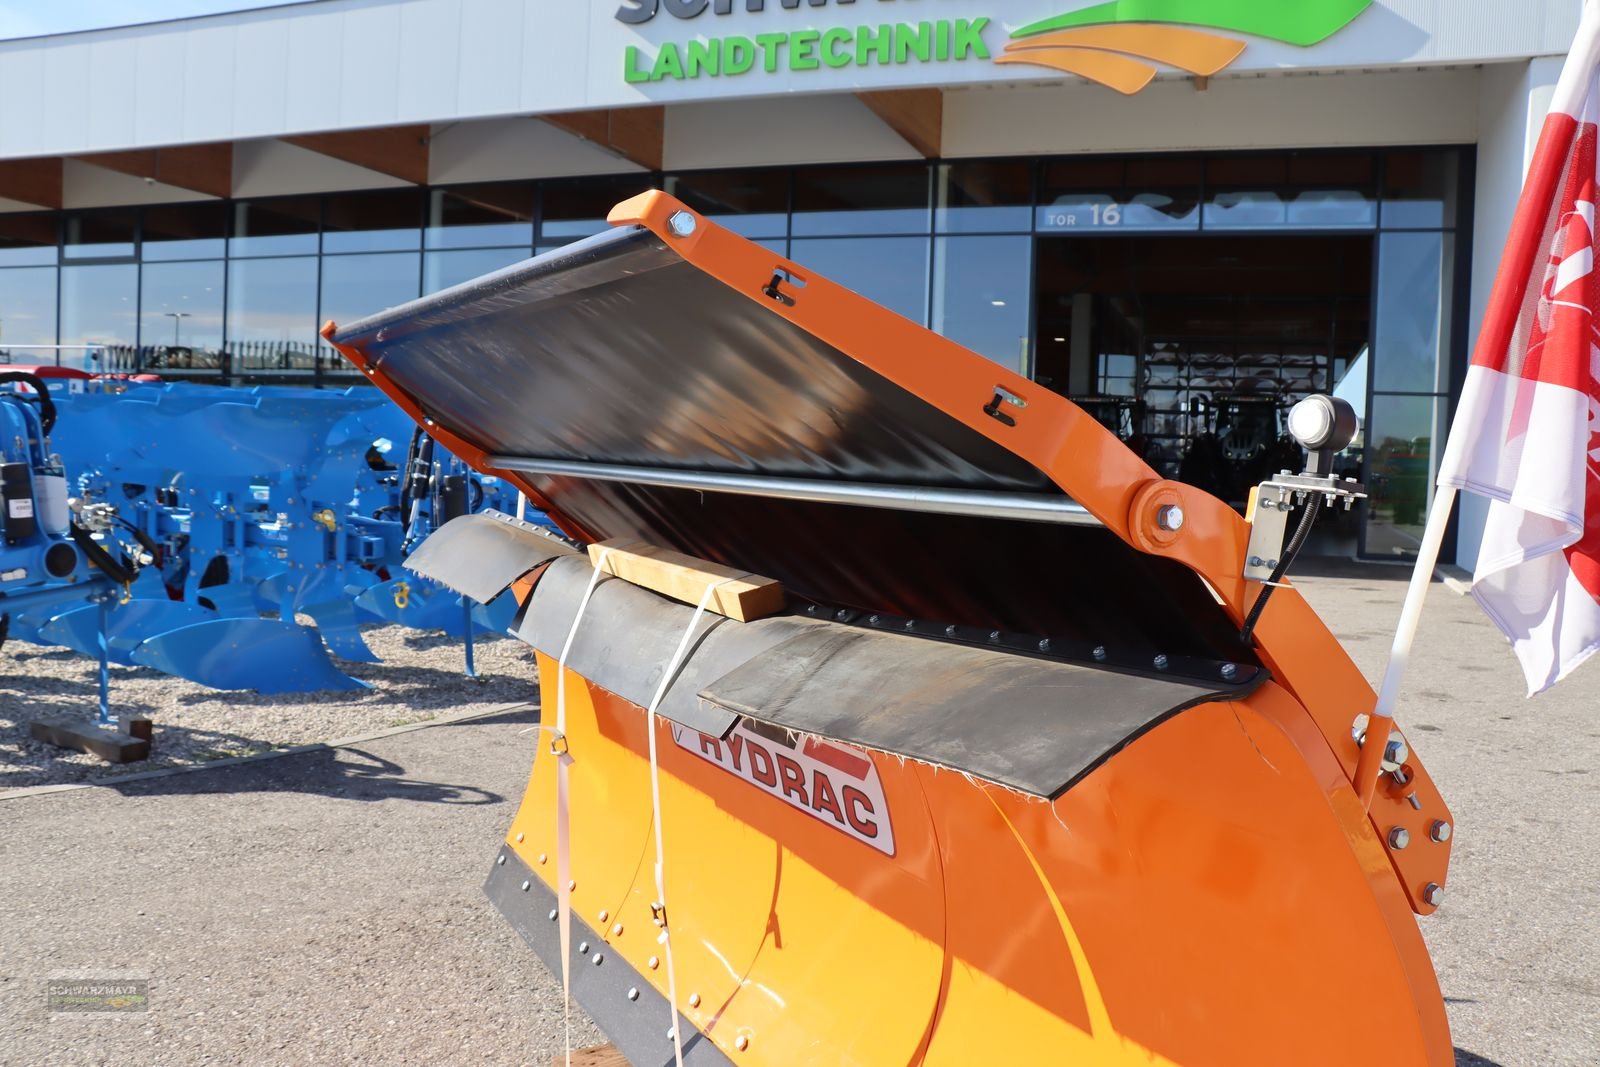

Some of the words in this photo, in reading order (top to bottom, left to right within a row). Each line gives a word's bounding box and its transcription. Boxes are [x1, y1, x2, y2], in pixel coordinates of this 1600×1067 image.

[624, 17, 991, 84] LANDTECHNIK
[1048, 215, 1076, 225] TOR
[1090, 203, 1121, 225] 16
